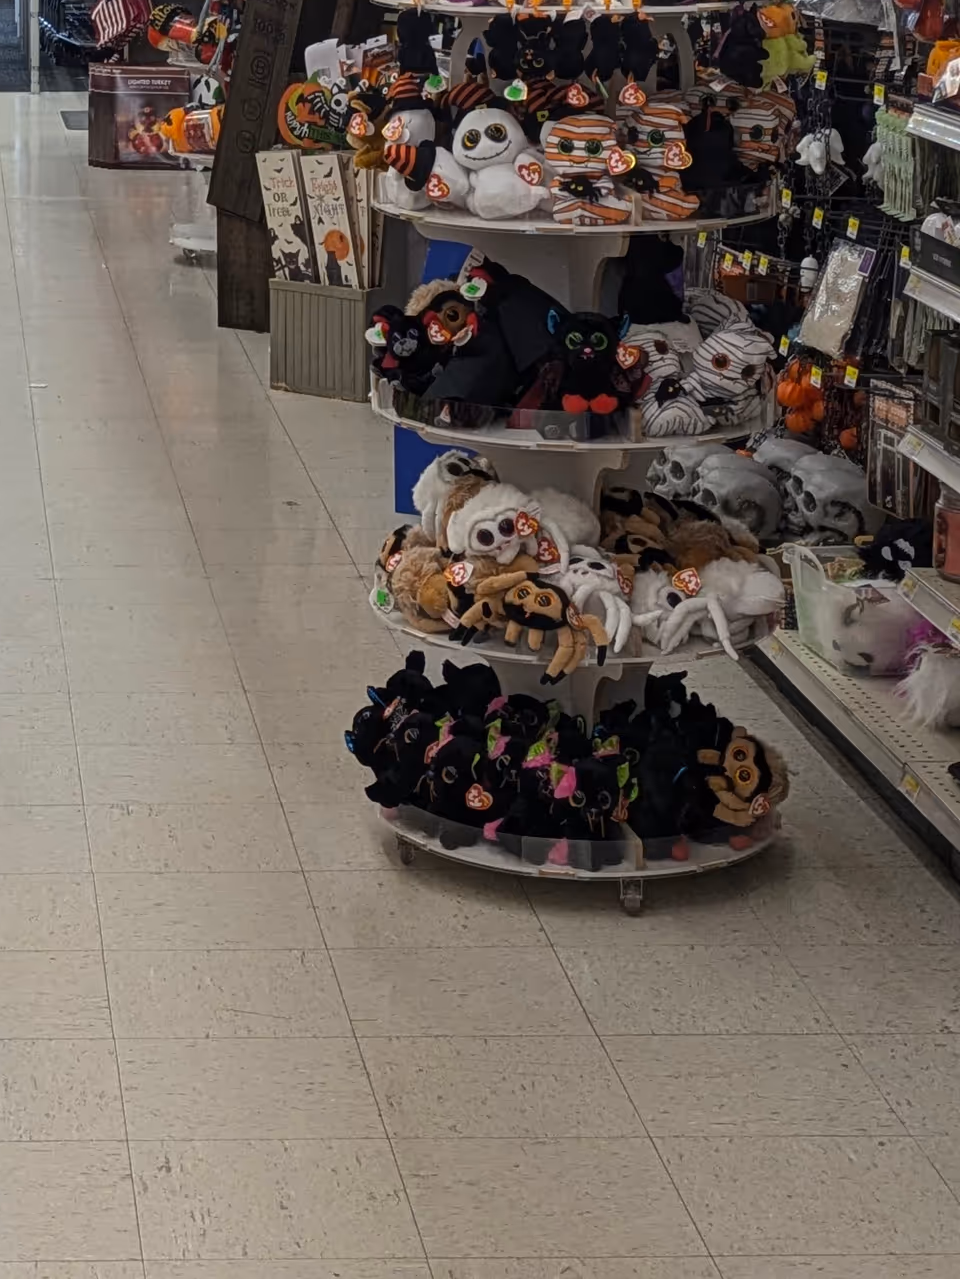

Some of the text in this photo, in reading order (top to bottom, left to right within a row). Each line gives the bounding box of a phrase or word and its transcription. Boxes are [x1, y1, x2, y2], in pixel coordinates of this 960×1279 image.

[270, 177, 295, 188] Trick
[273, 192, 288, 203] OR
[267, 204, 292, 218] Treat
